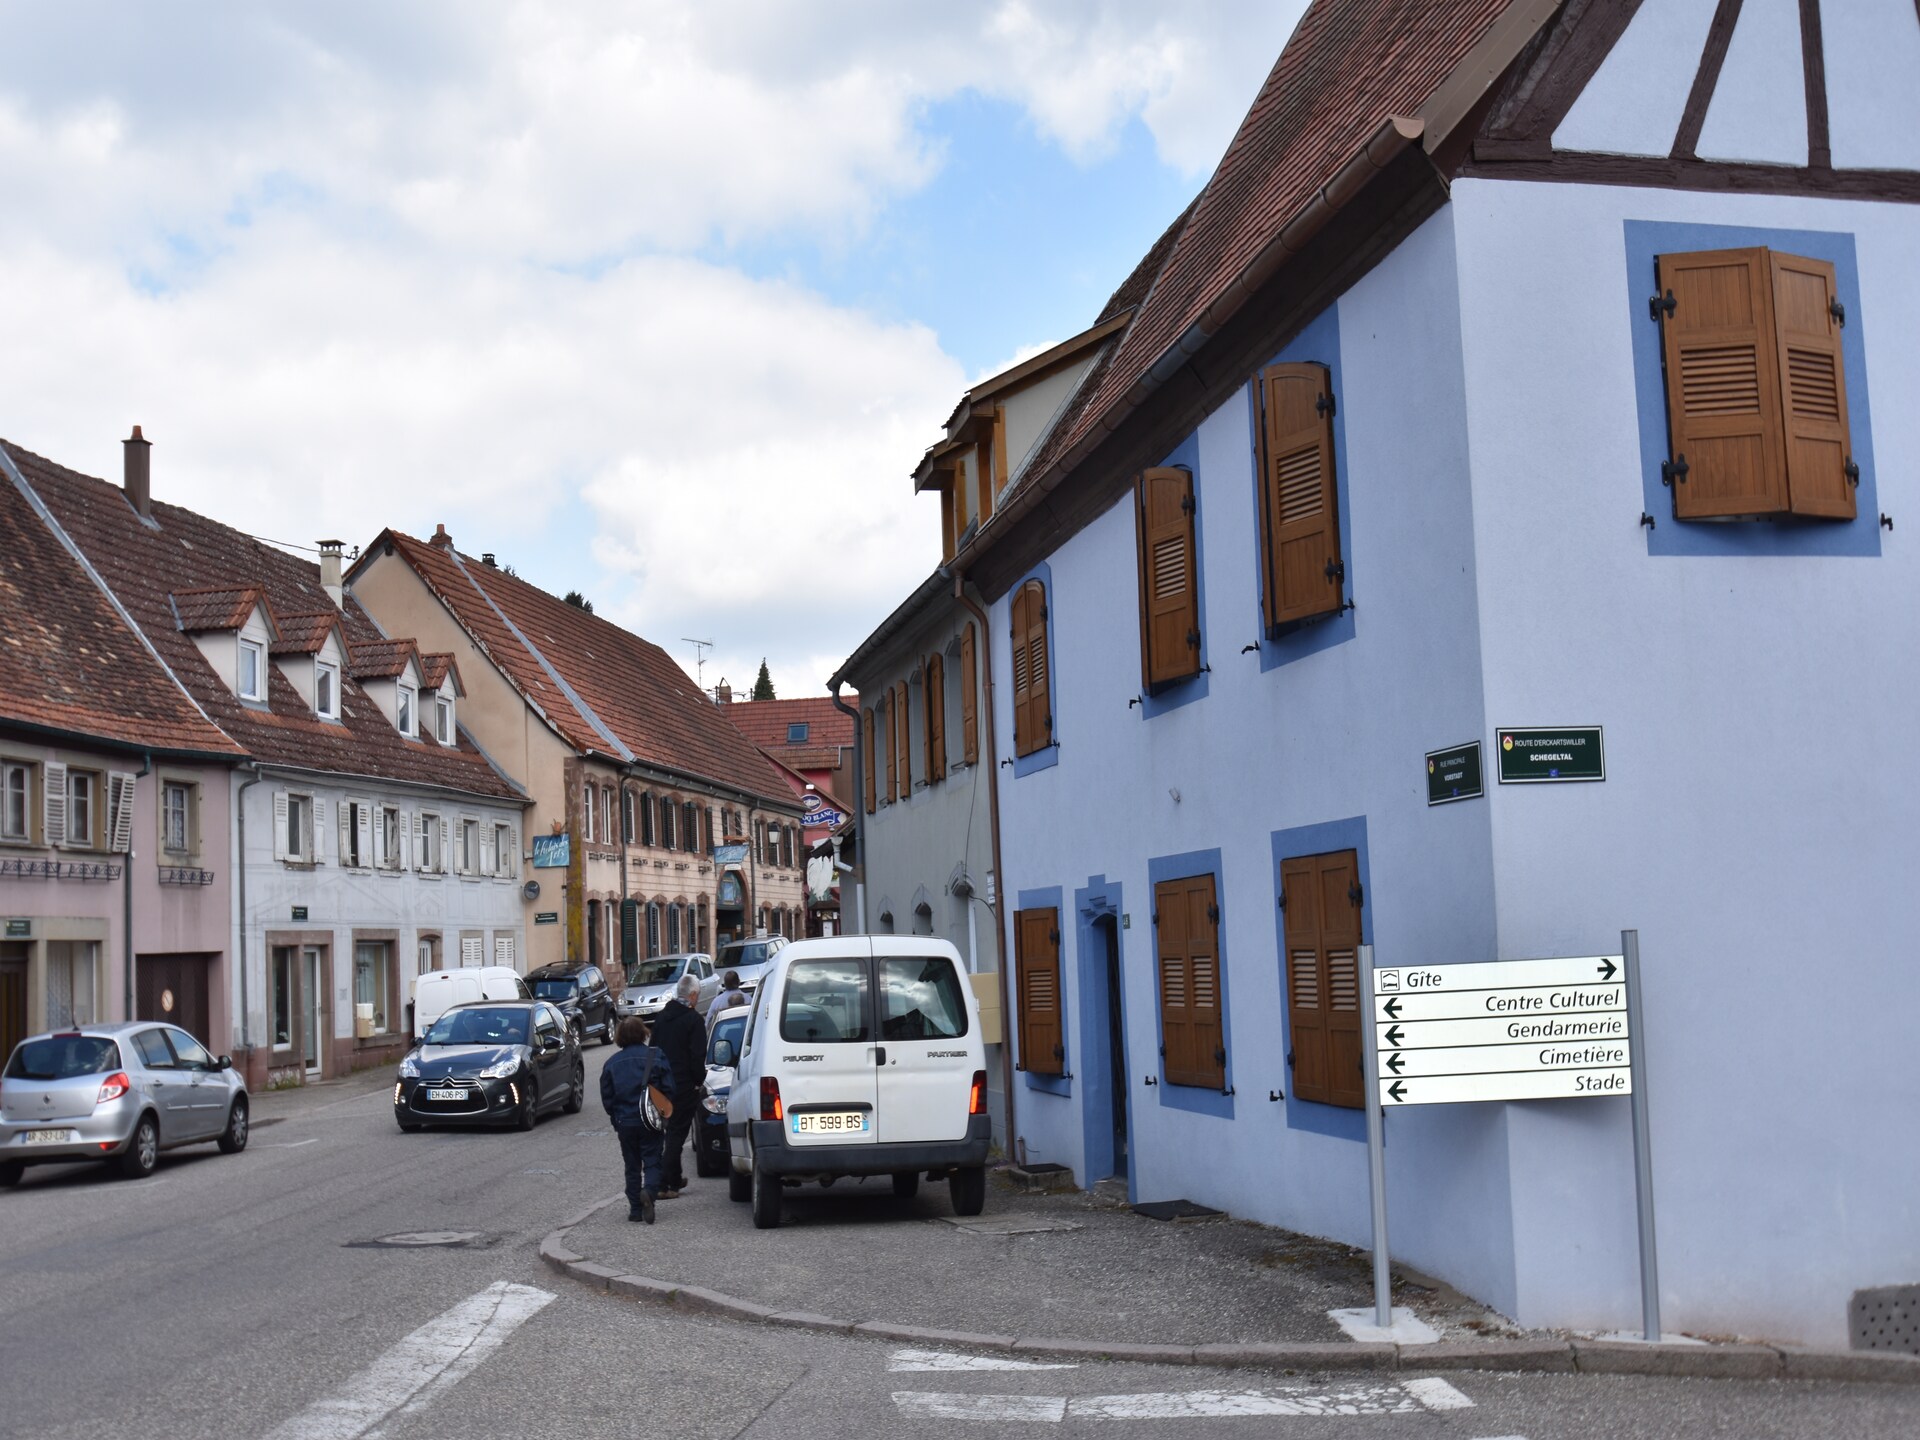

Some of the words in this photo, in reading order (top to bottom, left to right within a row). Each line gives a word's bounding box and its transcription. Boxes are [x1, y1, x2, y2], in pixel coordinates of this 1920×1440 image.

[1514, 739, 1533, 747] ROUTE
[1530, 753, 1573, 761] SCHEGELTAL
[813, 810, 833, 821] BLANC
[1406, 971, 1442, 988] Gîte
[1486, 994, 1543, 1012] Centre
[1549, 989, 1620, 1009] Culturel
[1507, 1017, 1622, 1039] Gendarmerie
[1539, 1045, 1624, 1065] Cimetière
[1575, 1073, 1625, 1092] Stade
